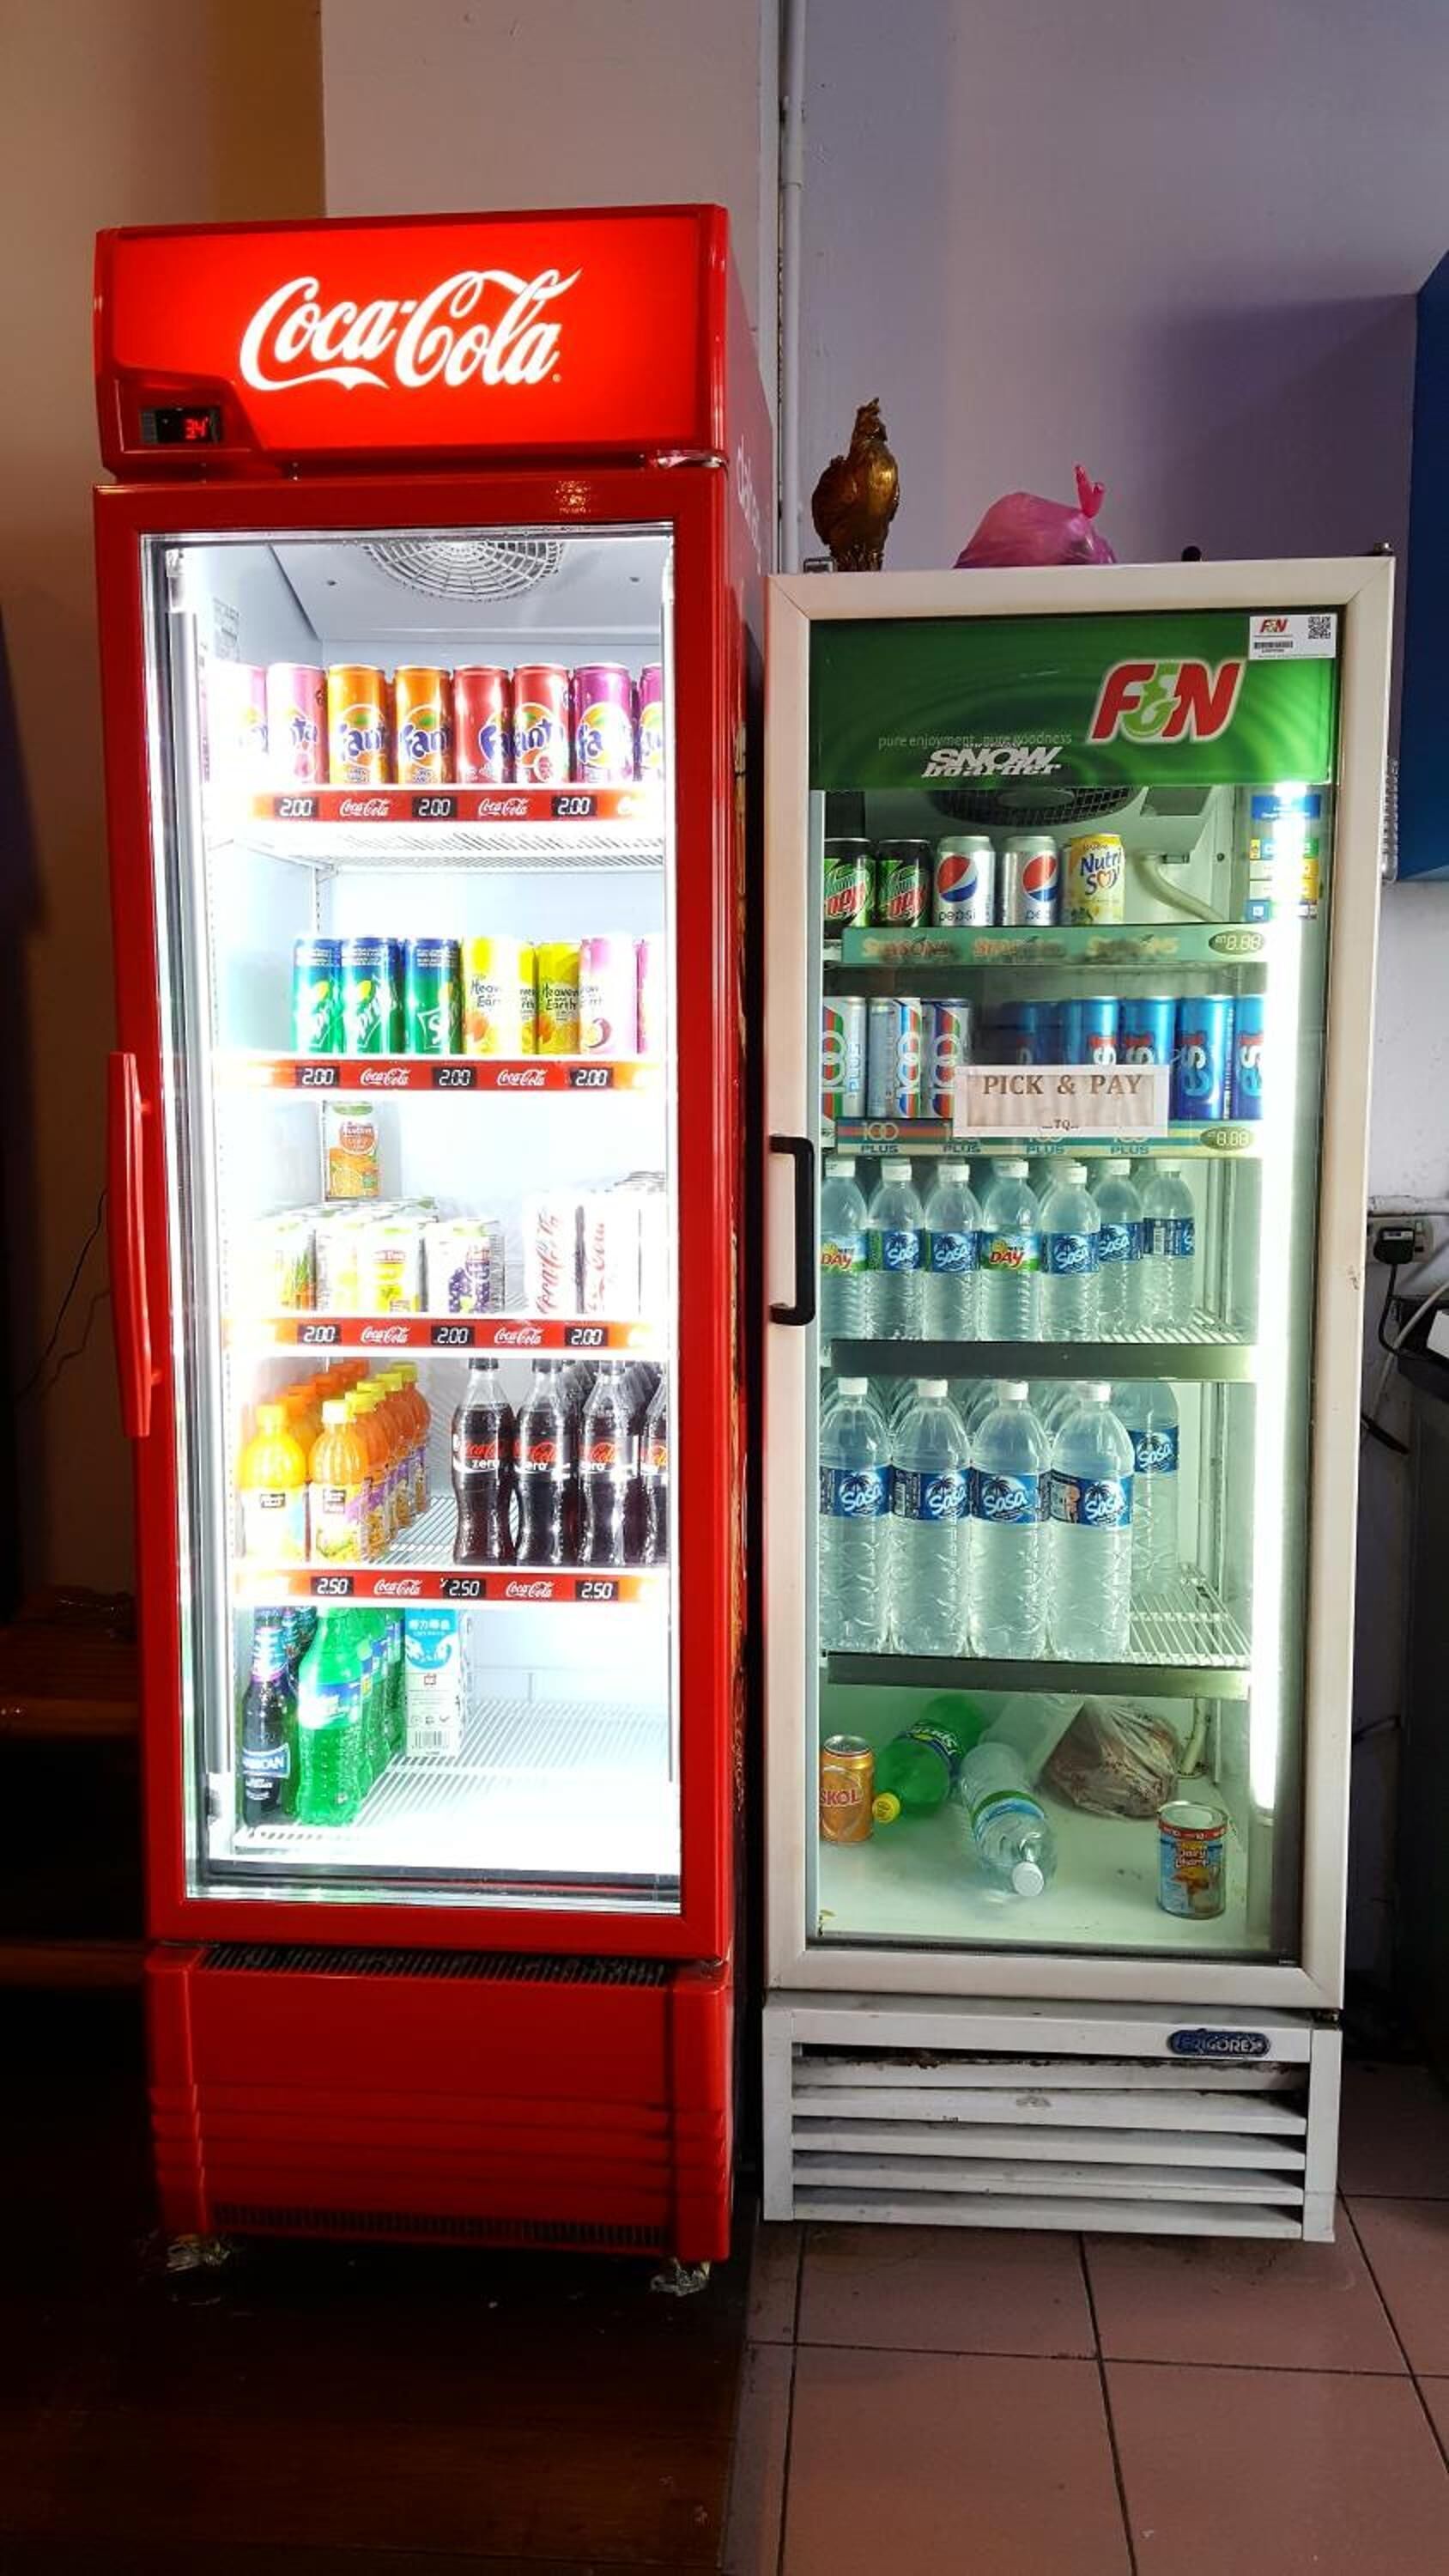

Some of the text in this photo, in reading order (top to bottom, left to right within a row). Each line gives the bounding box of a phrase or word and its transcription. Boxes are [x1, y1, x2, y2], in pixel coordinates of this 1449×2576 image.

[239, 269, 583, 391] Coca-Cola
[1088, 659, 1246, 744] F&N
[878, 736, 906, 750] pure
[1014, 732, 1072, 745] goodness
[930, 746, 1063, 769] SNOW
[280, 799, 312, 817] 2.00
[418, 799, 451, 817] 2.00
[558, 797, 591, 816] 2.00
[939, 908, 977, 921] pepsi
[302, 1070, 334, 1086] 2.00
[440, 1070, 471, 1087] 2.00
[576, 1069, 608, 1086] 2.00
[983, 1074, 1143, 1096] PICK & PAY
[863, 1121, 900, 1142] 100
[861, 1144, 899, 1153] PLUS
[943, 1143, 981, 1153] PLUS
[1026, 1145, 1064, 1155] PLUS
[1110, 1145, 1150, 1155] PLUS
[989, 1250, 1025, 1269] DAY
[303, 1326, 336, 1343] 2.00
[437, 1327, 469, 1345] 2.00
[571, 1327, 603, 1346] 2.00
[472, 1460, 500, 1469] zero
[317, 1577, 349, 1595] 2.50
[449, 1580, 481, 1597] 2.50
[581, 1583, 613, 1600] 2.50
